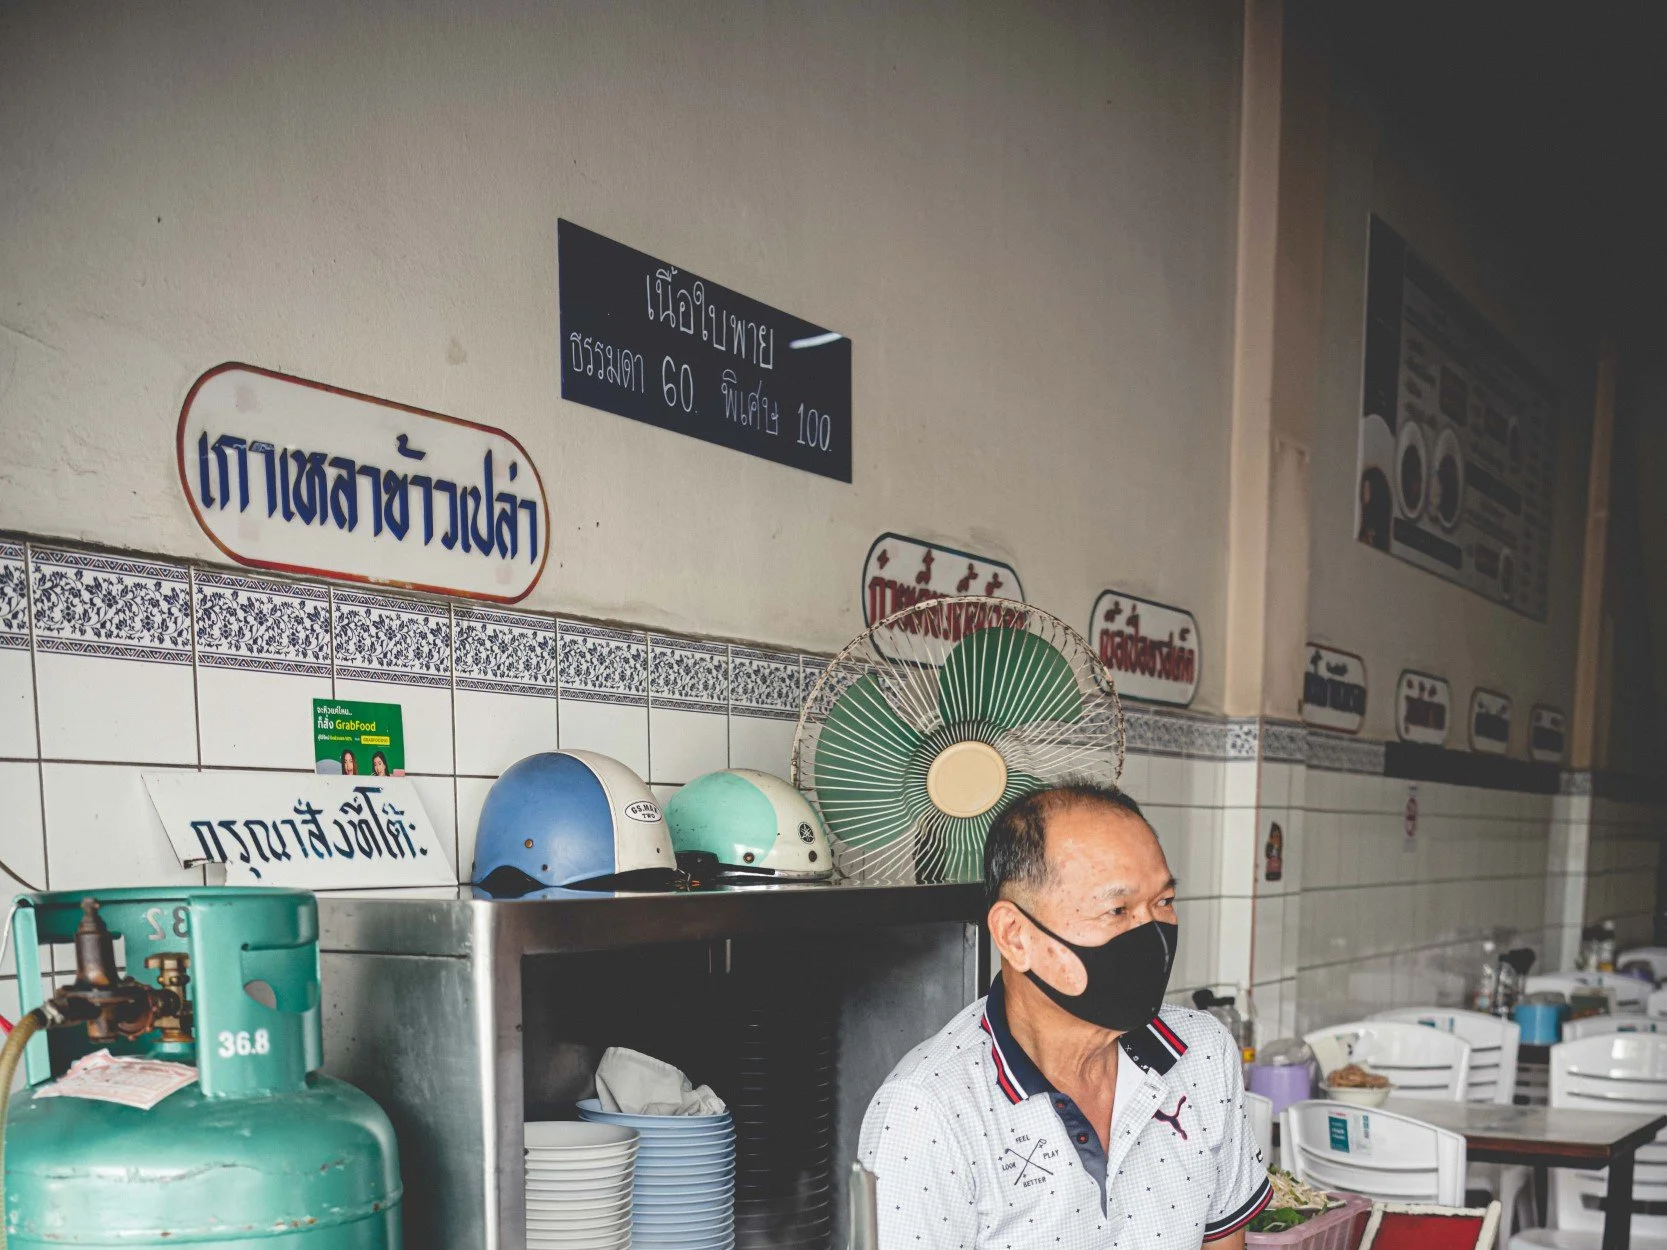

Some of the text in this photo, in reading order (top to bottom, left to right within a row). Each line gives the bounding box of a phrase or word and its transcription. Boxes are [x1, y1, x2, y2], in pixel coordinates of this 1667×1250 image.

[569, 332, 645, 393] ธรรมดา
[721, 369, 779, 436] พิเศษ
[198, 432, 539, 566] เกาเหลาข้าวเปล่า
[335, 720, 376, 731] GrabFood
[218, 1028, 271, 1059] 36.8
[1015, 1135, 1030, 1143] FEEL
[1043, 1149, 1059, 1159] PLAY
[1002, 1162, 1016, 1171] LOOK
[1023, 1176, 1046, 1187] BETTER
